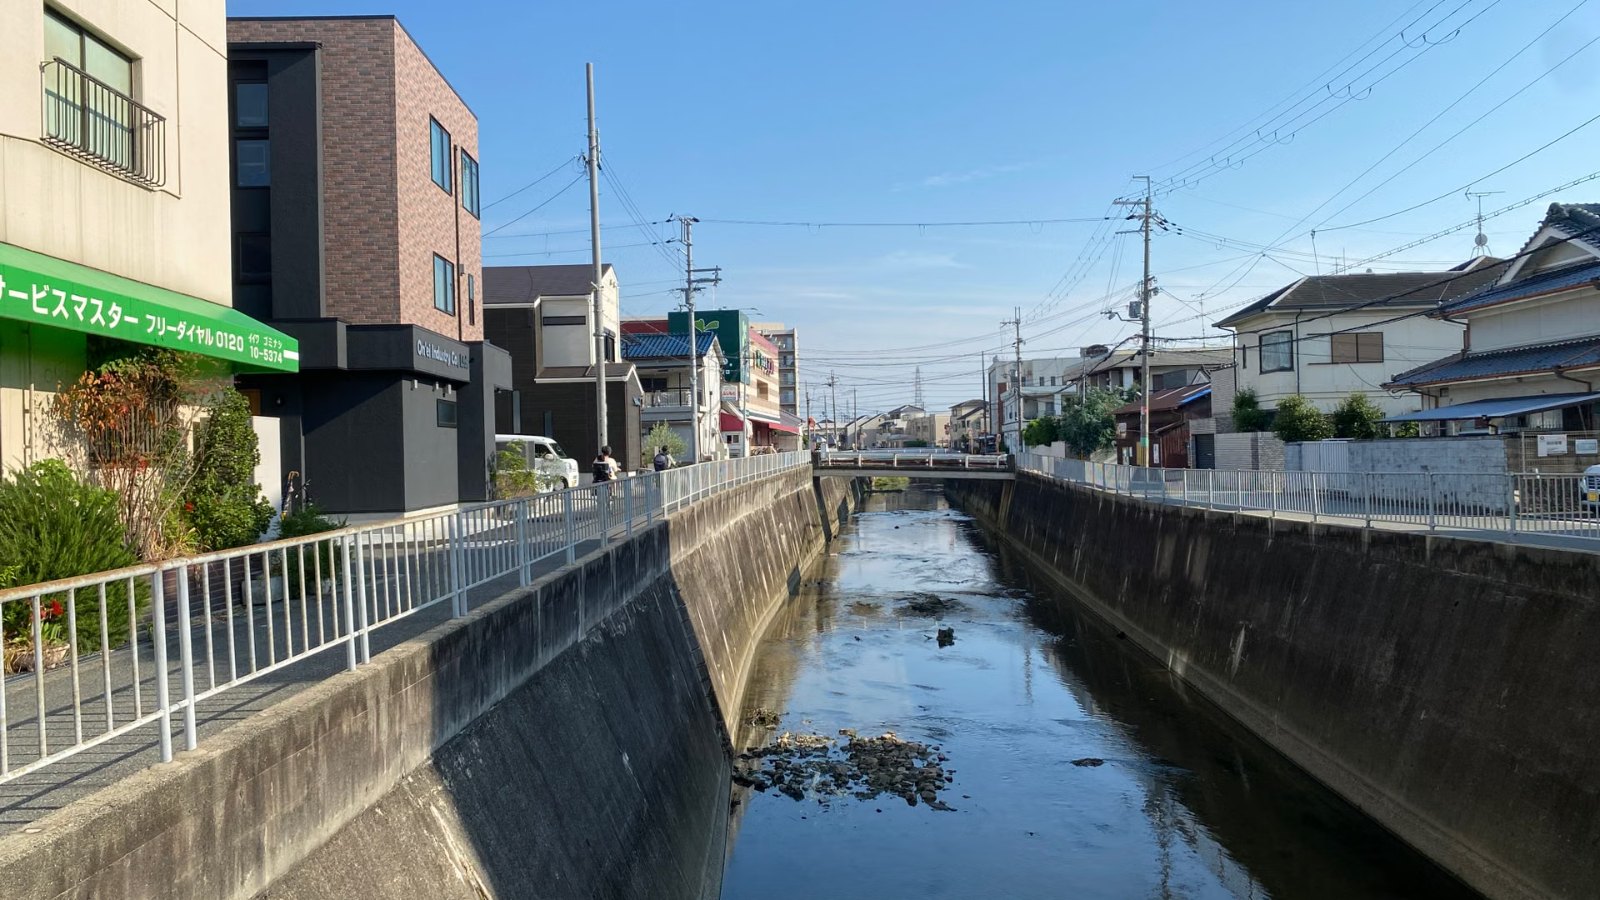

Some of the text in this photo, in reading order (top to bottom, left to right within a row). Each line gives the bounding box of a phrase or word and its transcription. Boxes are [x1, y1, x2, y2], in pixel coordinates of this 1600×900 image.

[146, 314, 214, 346] フリーダイヤル
[216, 331, 244, 352] 0120
[249, 346, 283, 364] 10-5374
